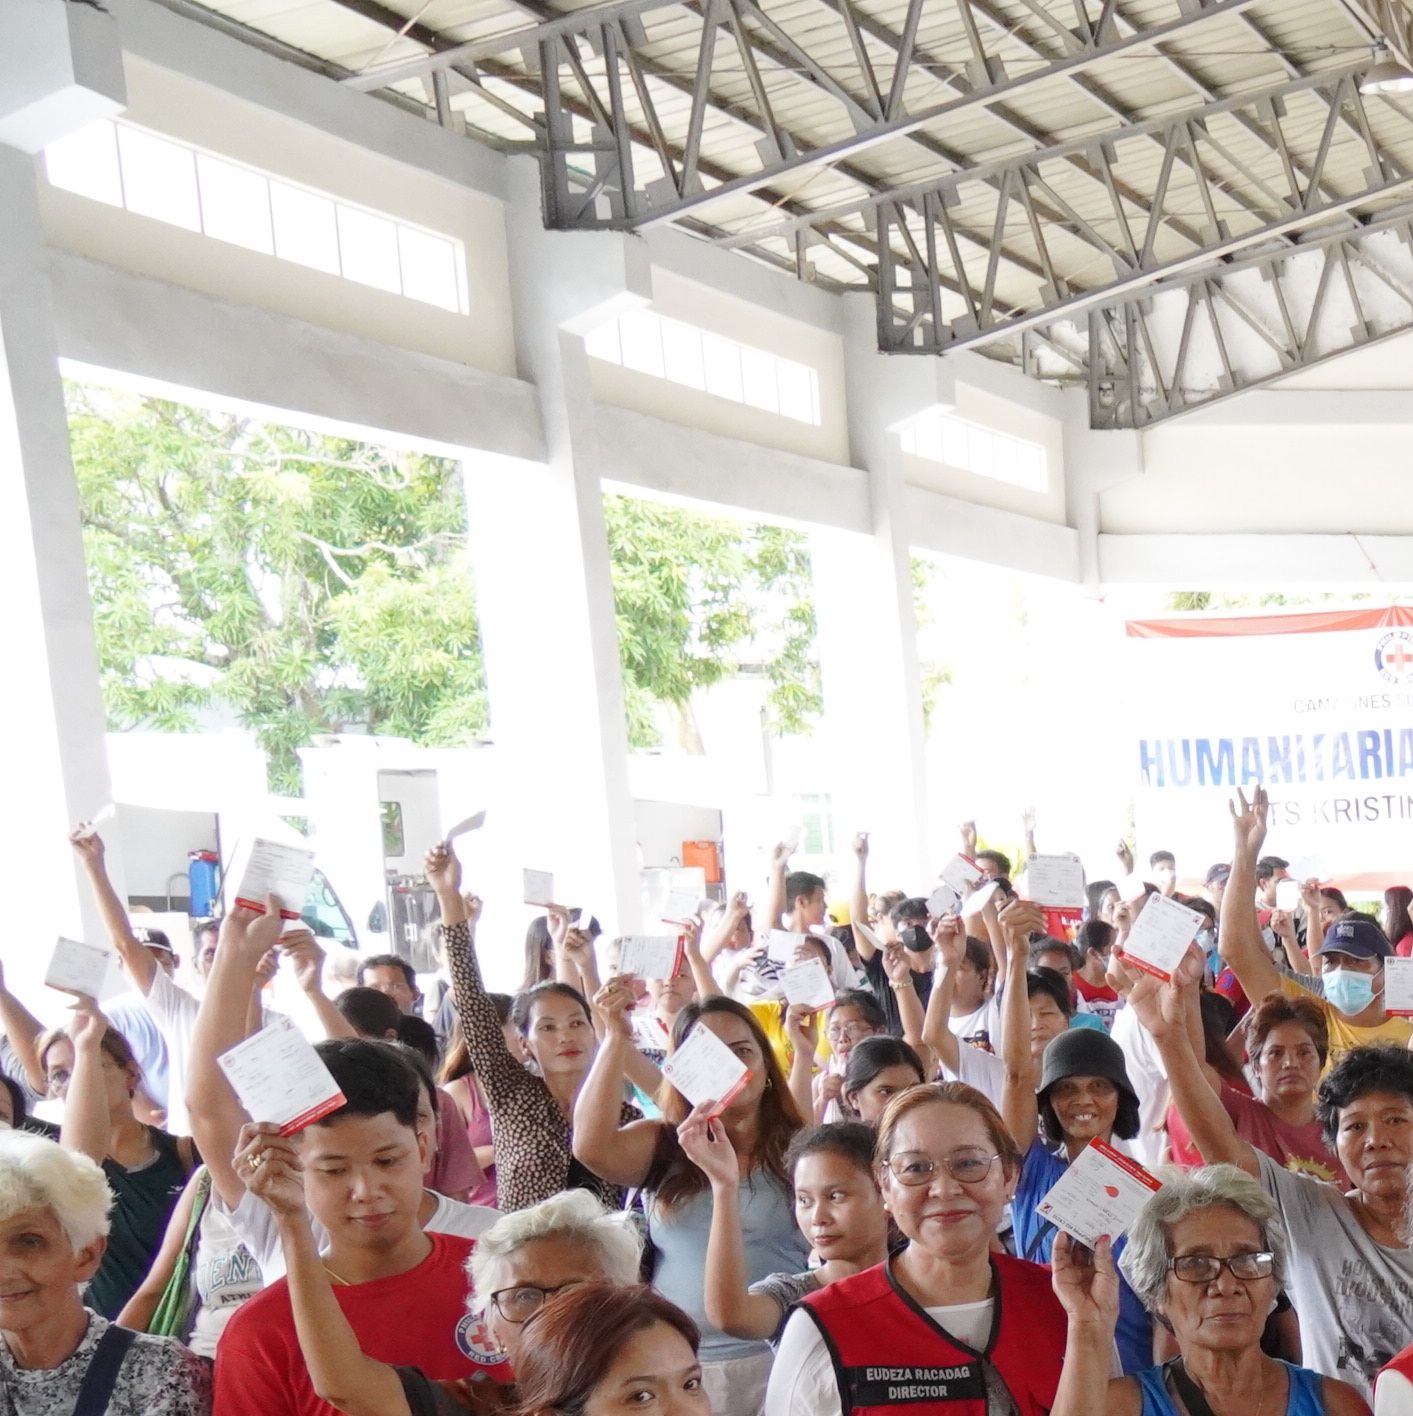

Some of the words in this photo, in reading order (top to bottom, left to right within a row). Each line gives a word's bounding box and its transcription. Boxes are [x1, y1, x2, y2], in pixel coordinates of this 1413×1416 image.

[866, 1367, 913, 1381] EUDEZA
[914, 1366, 970, 1380] RACADAG
[888, 1385, 948, 1399] DIRECTOR
